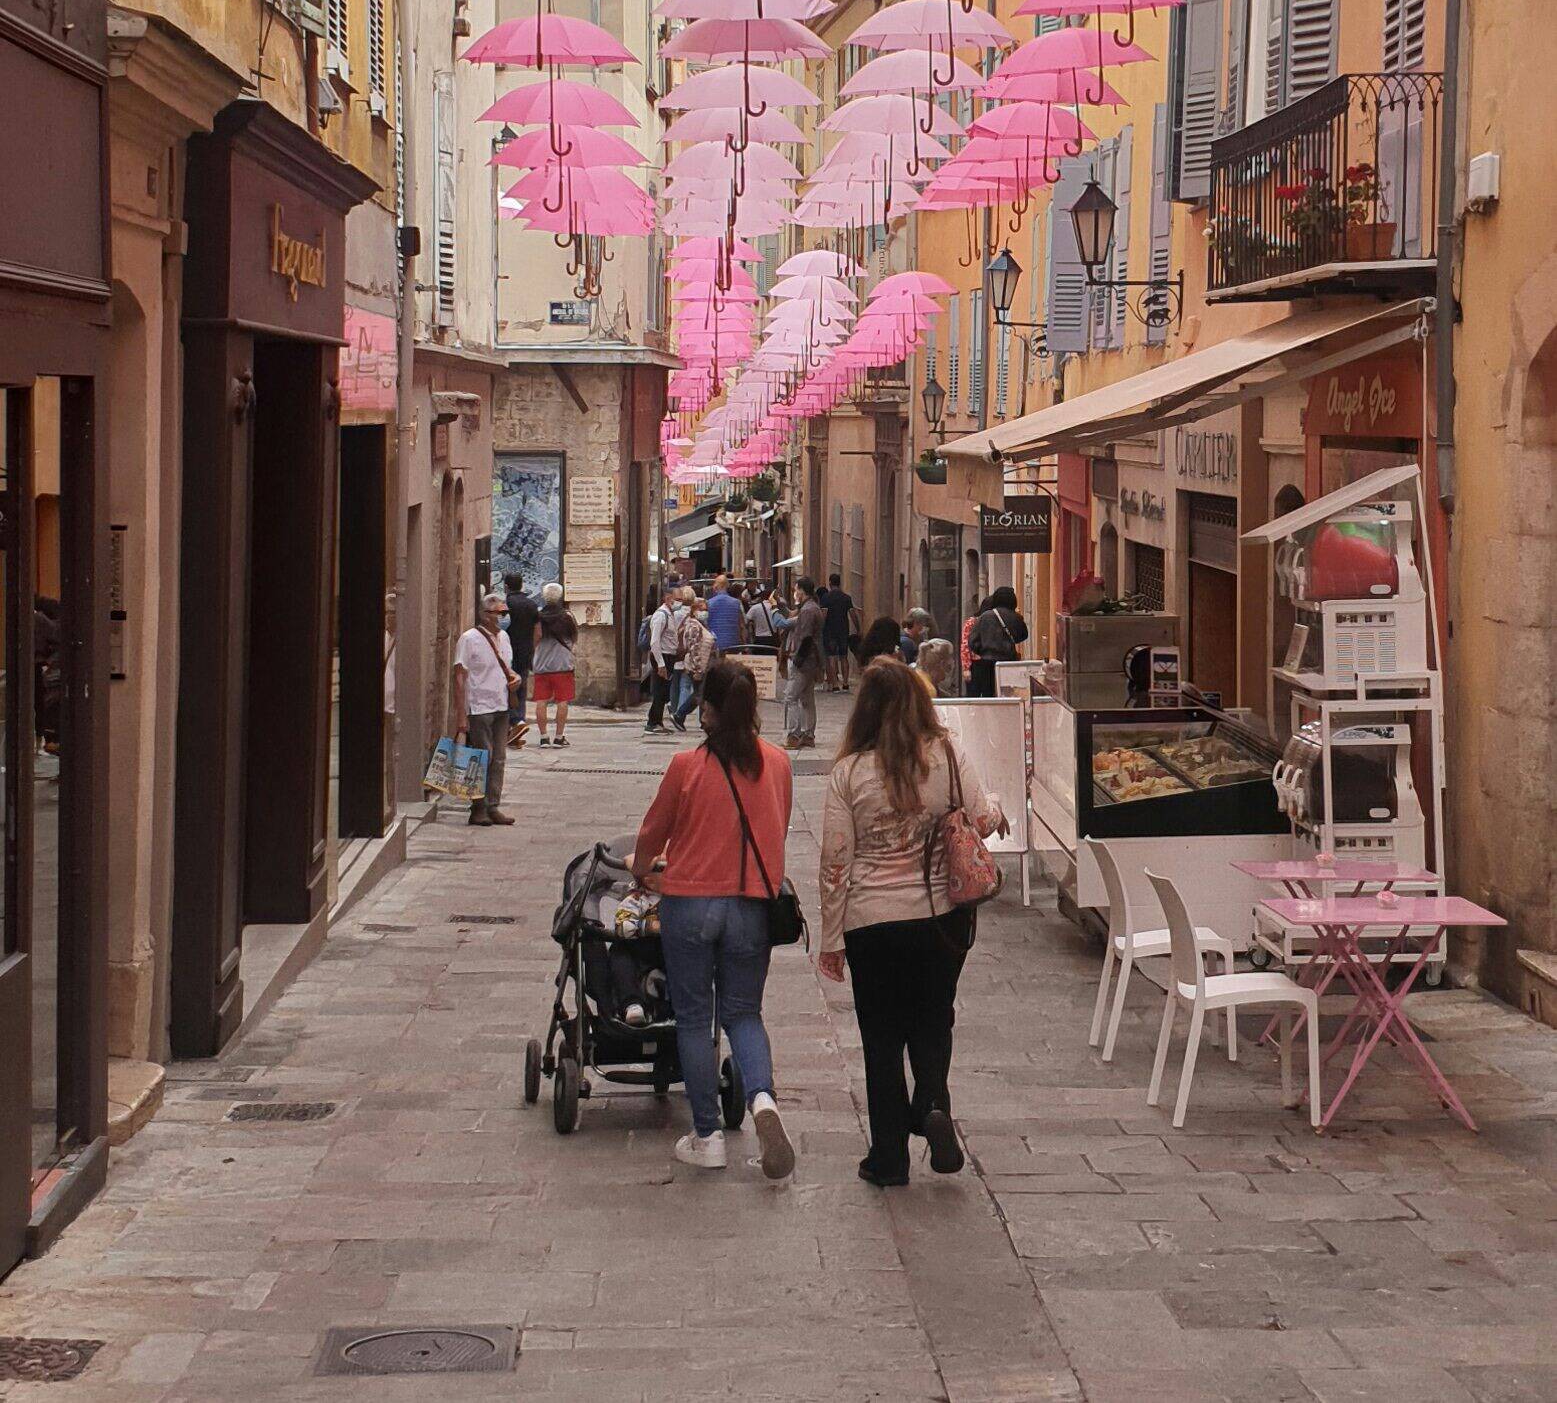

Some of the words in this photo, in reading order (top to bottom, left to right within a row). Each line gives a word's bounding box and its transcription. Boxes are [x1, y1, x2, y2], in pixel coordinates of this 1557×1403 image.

[1327, 376, 1365, 432] Angel
[1369, 371, 1396, 427] Ice
[984, 511, 1048, 527] FLORIAN
